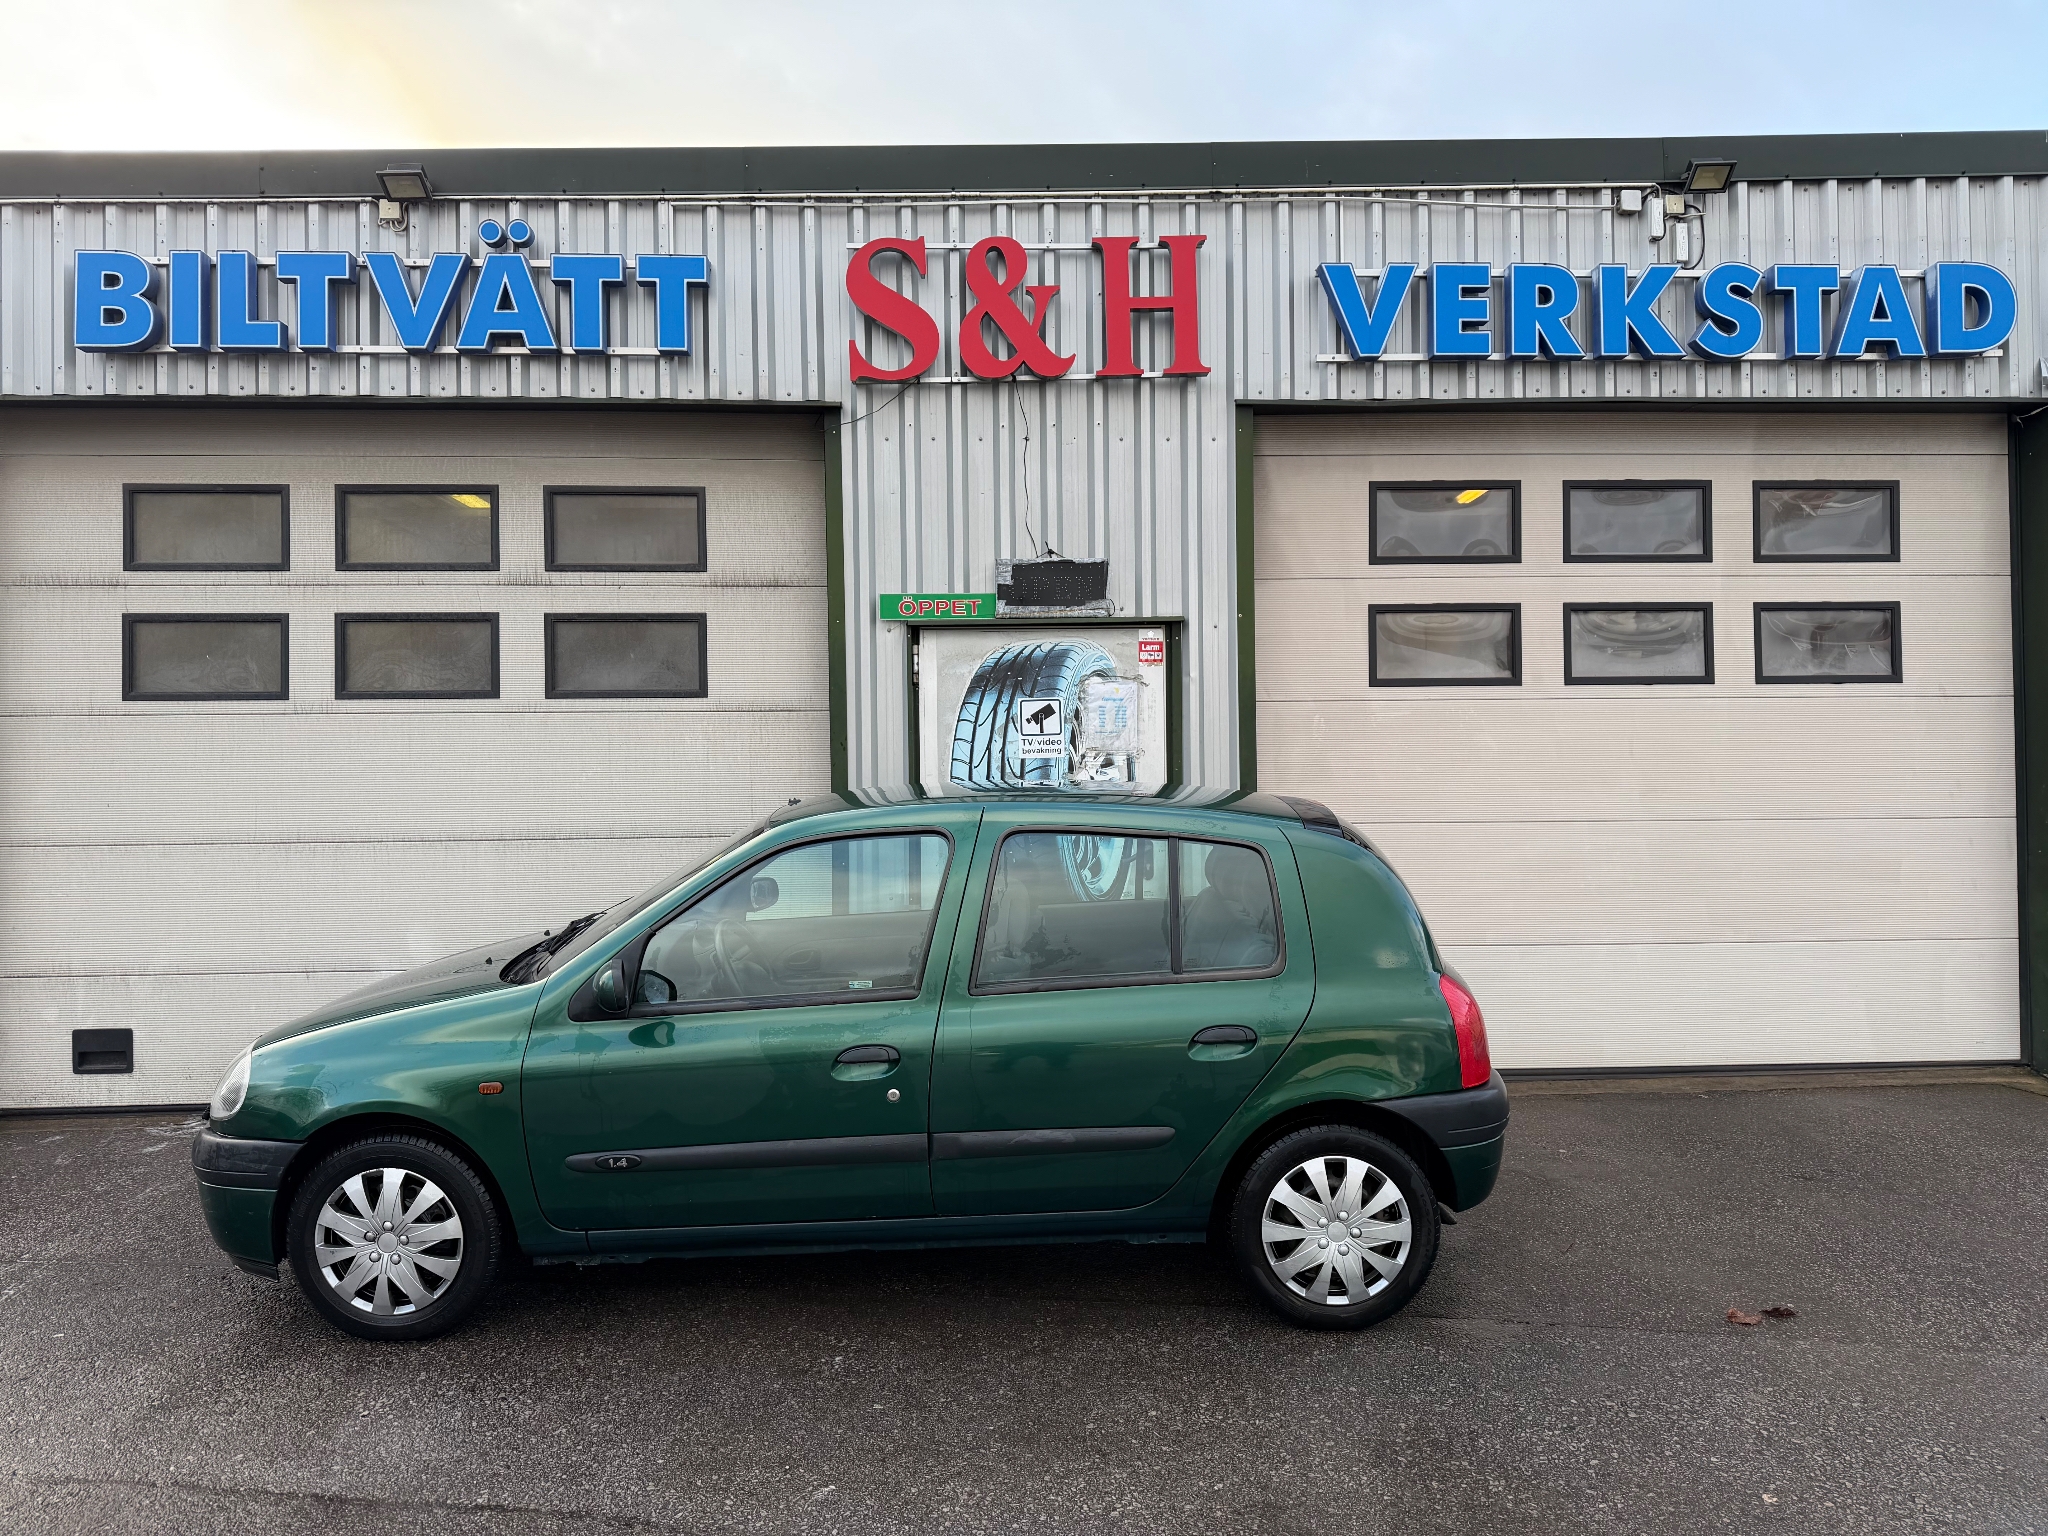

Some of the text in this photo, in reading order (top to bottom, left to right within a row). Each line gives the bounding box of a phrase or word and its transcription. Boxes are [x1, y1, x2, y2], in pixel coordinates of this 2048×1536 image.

[74, 219, 710, 356] BILTVÄTT
[846, 235, 1212, 383] S&H
[1317, 261, 2018, 361] VERKSTAD
[1008, 576, 1093, 600] OPEN
[898, 596, 981, 616] ÖPPET
[1141, 643, 1160, 651] Larm
[1021, 738, 1062, 746] TV/video
[1022, 747, 1062, 755] bevakning
[609, 1157, 628, 1168] 1.4
